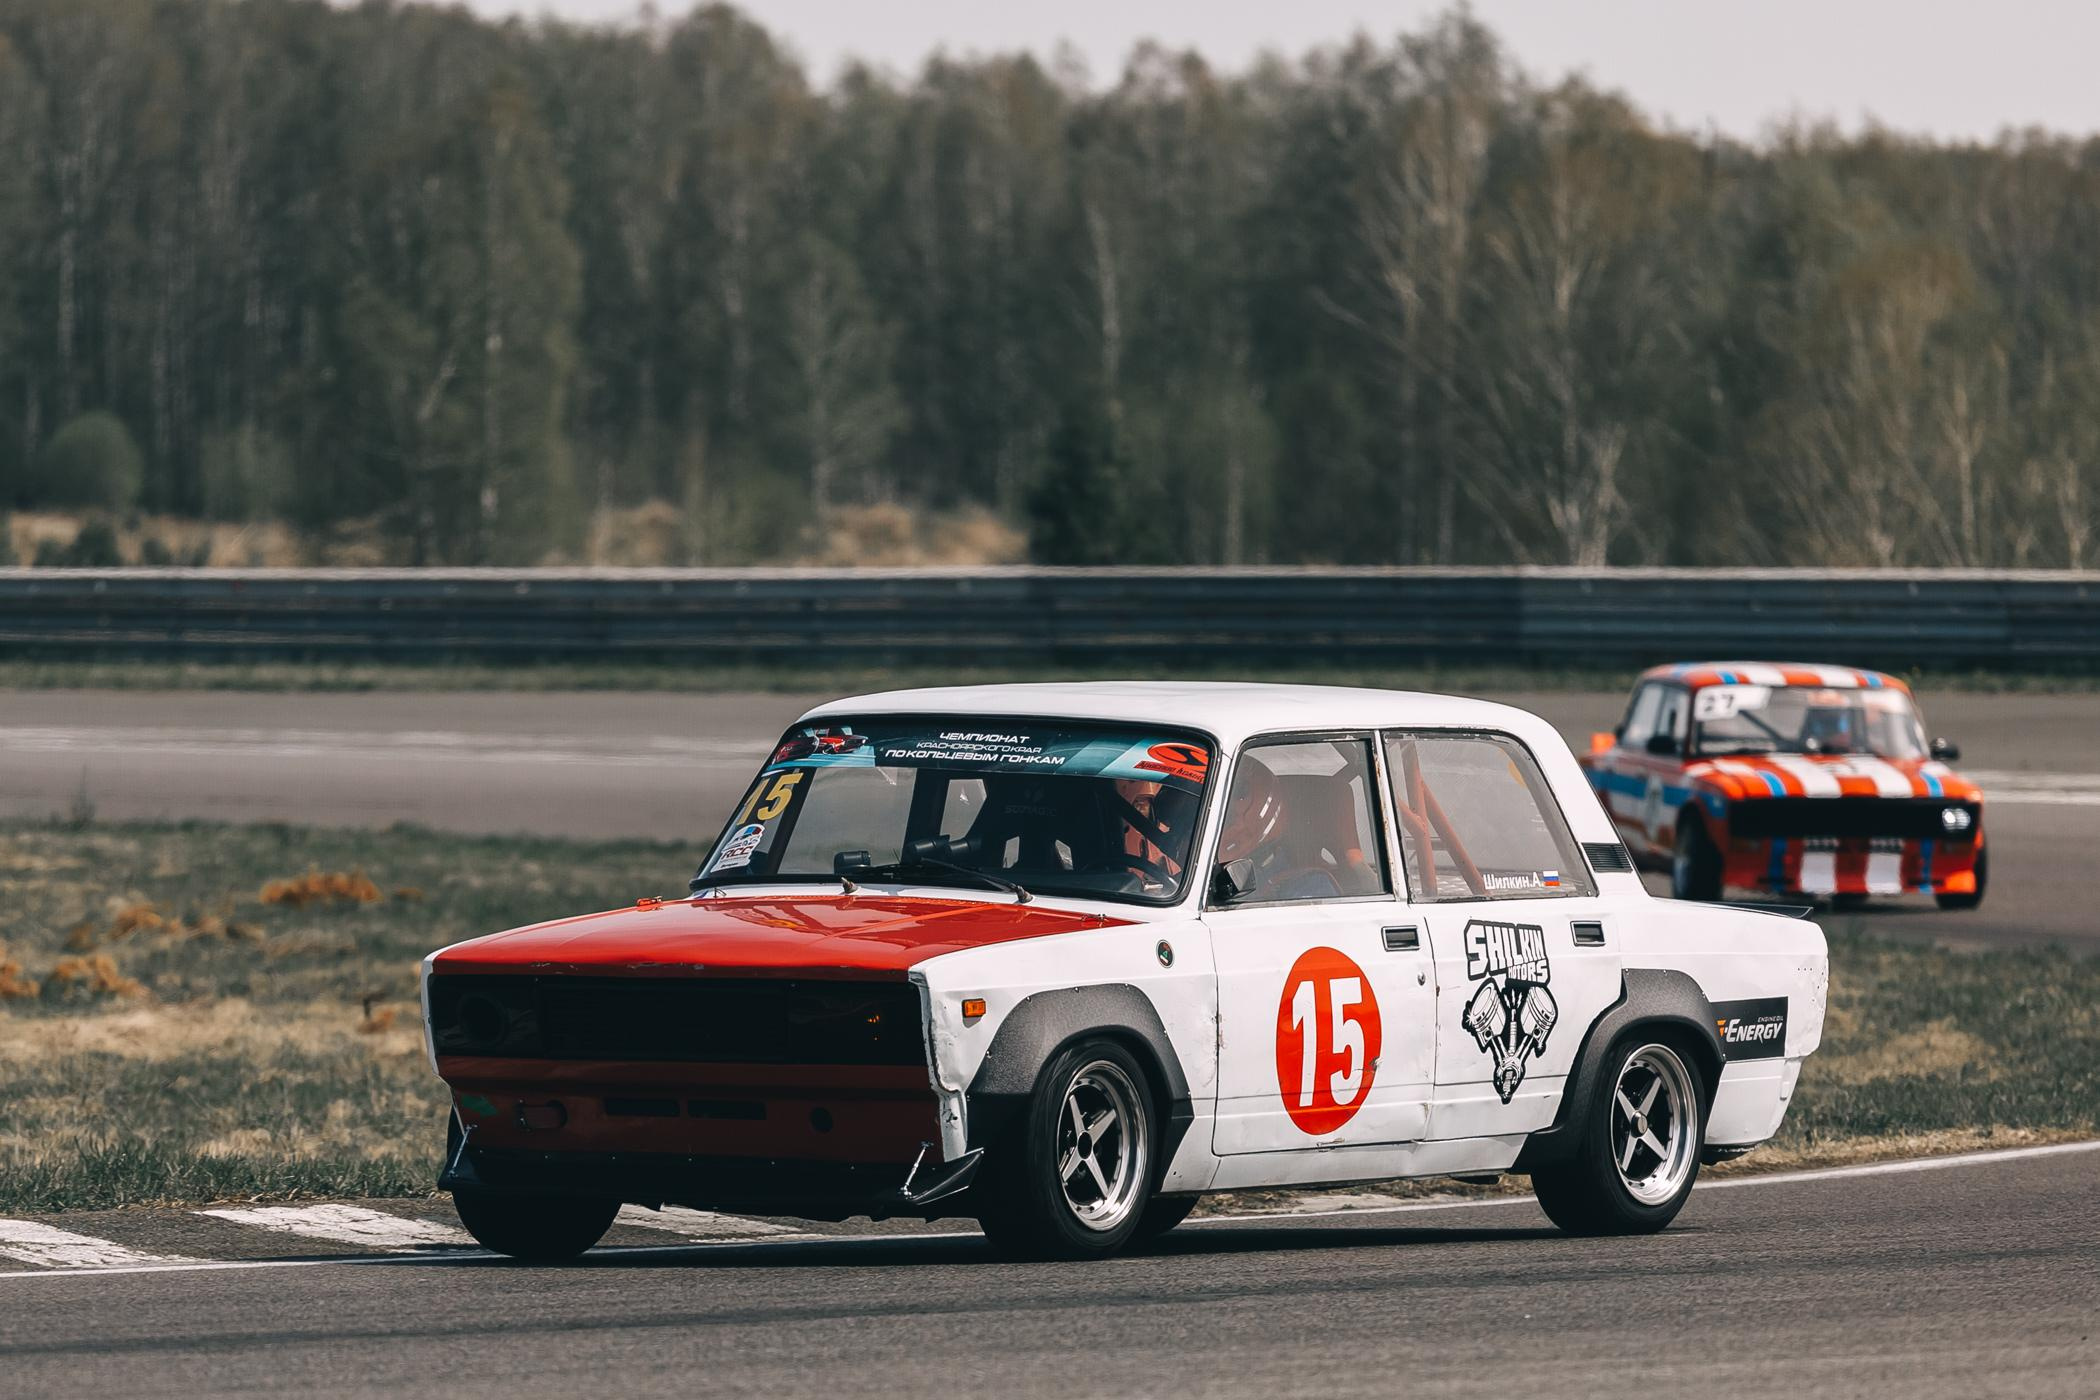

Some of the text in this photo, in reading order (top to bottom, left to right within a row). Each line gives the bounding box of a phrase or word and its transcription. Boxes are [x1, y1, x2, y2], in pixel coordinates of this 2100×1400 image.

[1704, 694, 1735, 712] 27
[940, 732, 1030, 743] ЧЕМПИОНАТ
[885, 749, 1065, 765] ПО КОЛЬЦЕВЫМ ГОНКАМ
[736, 773, 804, 825] 15
[1466, 924, 1545, 976] SHILKIN
[1507, 960, 1547, 984] MOTORS
[1293, 977, 1364, 1108] 15
